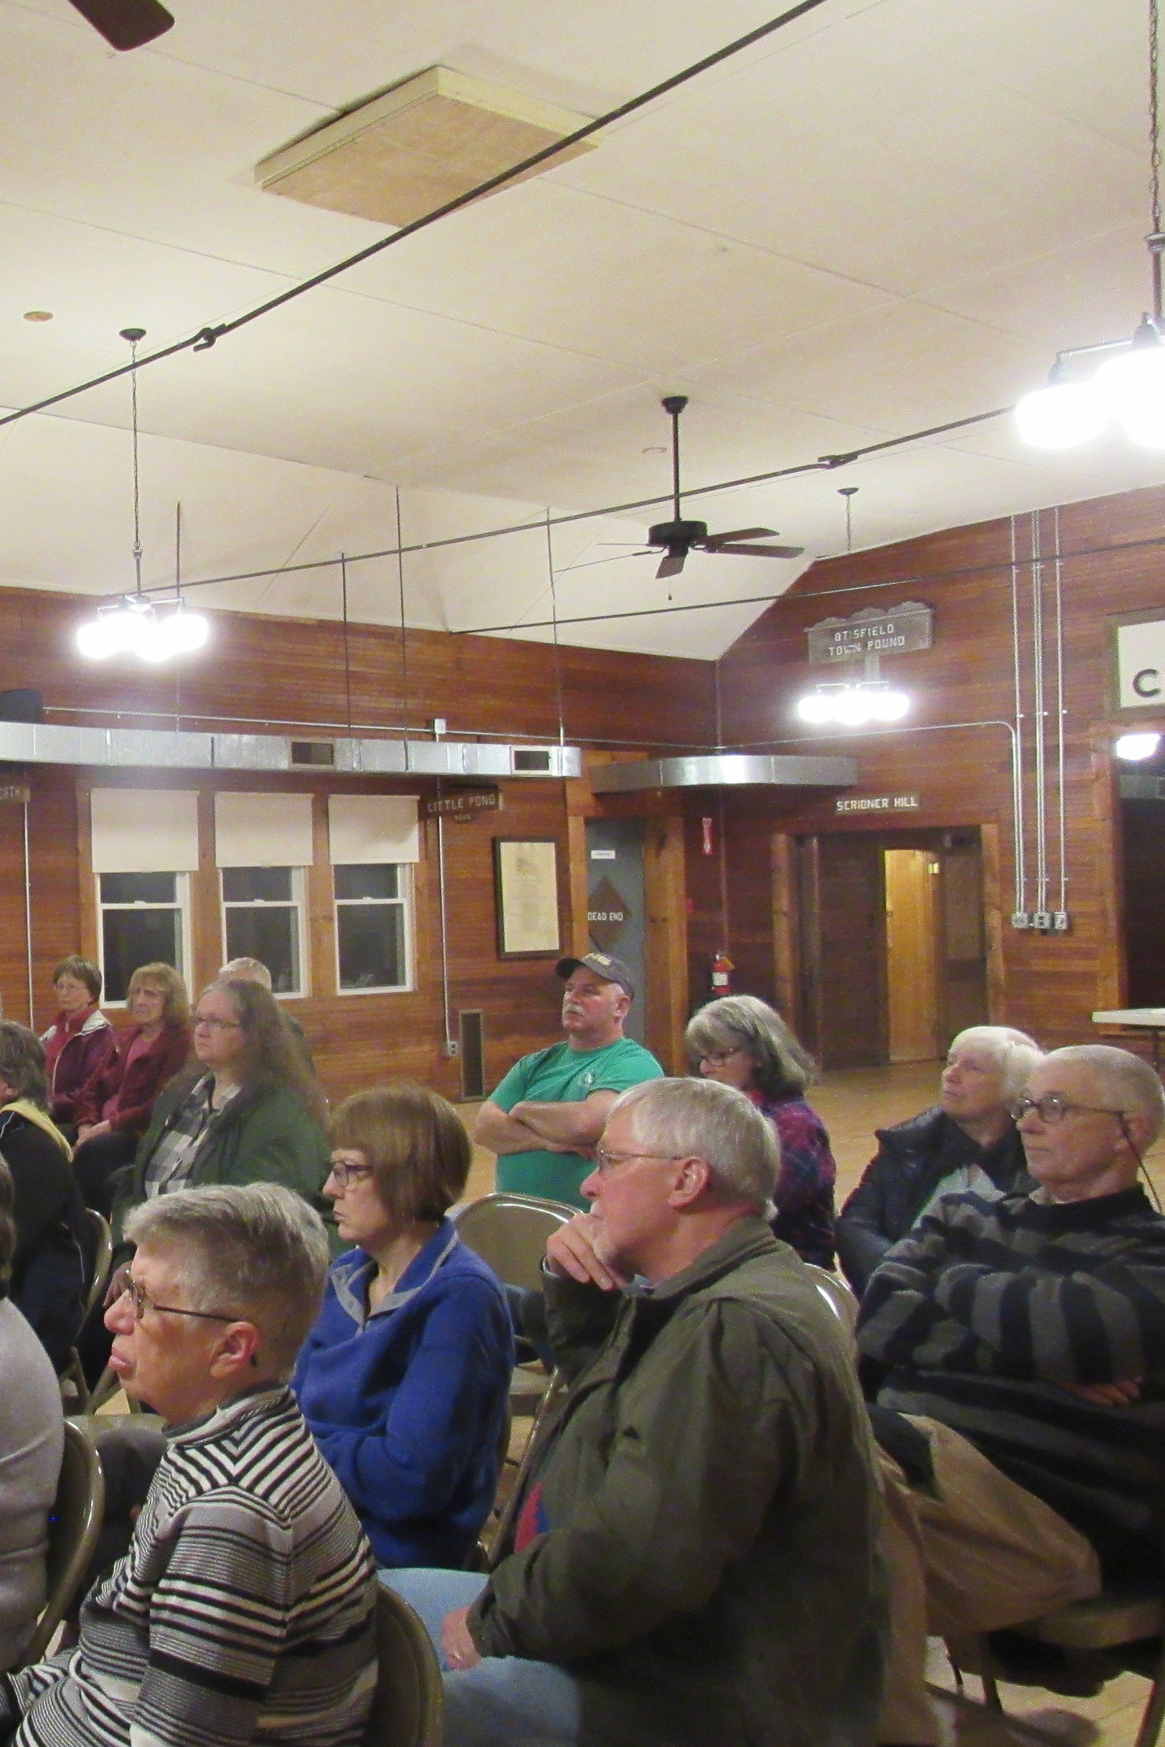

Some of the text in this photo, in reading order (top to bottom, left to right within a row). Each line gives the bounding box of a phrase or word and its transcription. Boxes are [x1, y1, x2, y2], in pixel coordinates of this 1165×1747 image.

[867, 635, 906, 651] POUND
[427, 793, 496, 813] LITTLE POND
[893, 796, 918, 808] HILL
[587, 911, 624, 922] DEAD END
